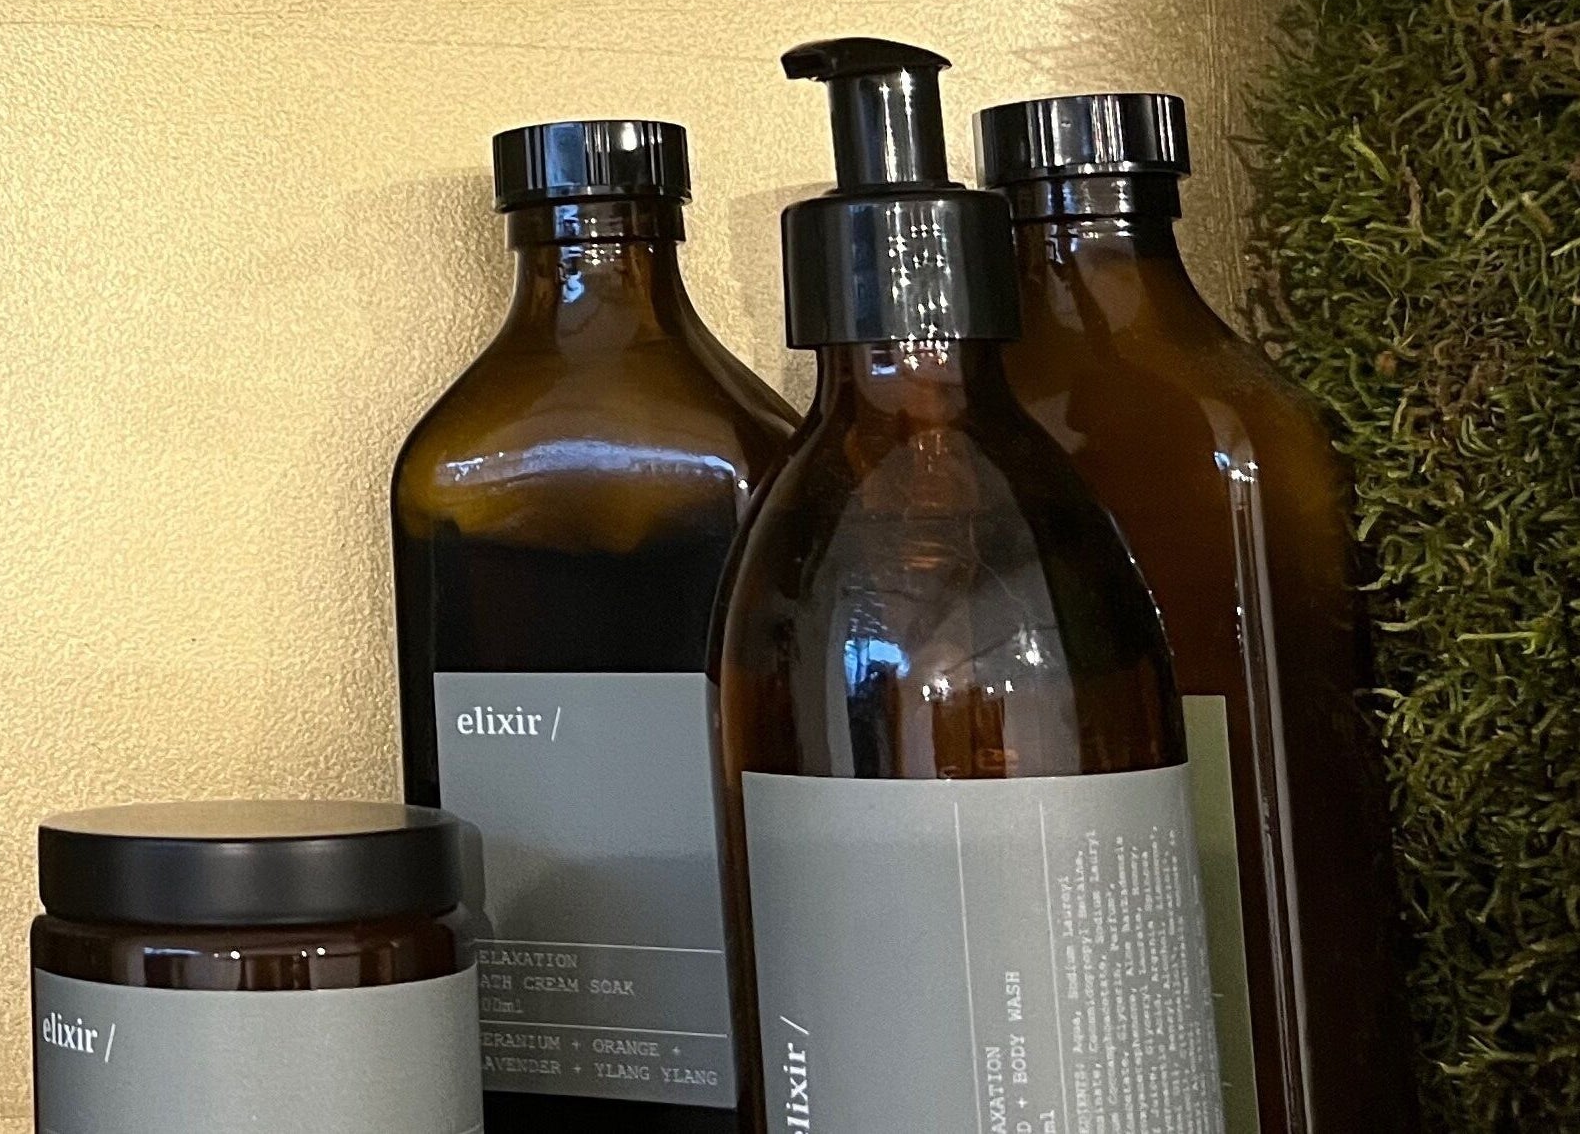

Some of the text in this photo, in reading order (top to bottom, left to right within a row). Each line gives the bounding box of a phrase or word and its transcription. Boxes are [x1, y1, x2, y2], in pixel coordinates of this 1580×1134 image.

[456, 705, 542, 736] elixir
[477, 949, 579, 968] ELAXATION
[480, 973, 635, 996] ATH CREAM SOAK
[1006, 971, 1024, 1022] WASH
[42, 1011, 98, 1054] elixir
[481, 1032, 561, 1050] ERANIUM
[592, 1038, 661, 1057] ORANGE
[483, 1055, 562, 1075] AVENDER
[593, 1062, 650, 1081] YLANG
[660, 1067, 719, 1086] YLANG
[1009, 1033, 1028, 1084] BODY
[984, 1046, 1008, 1134] AXATION
